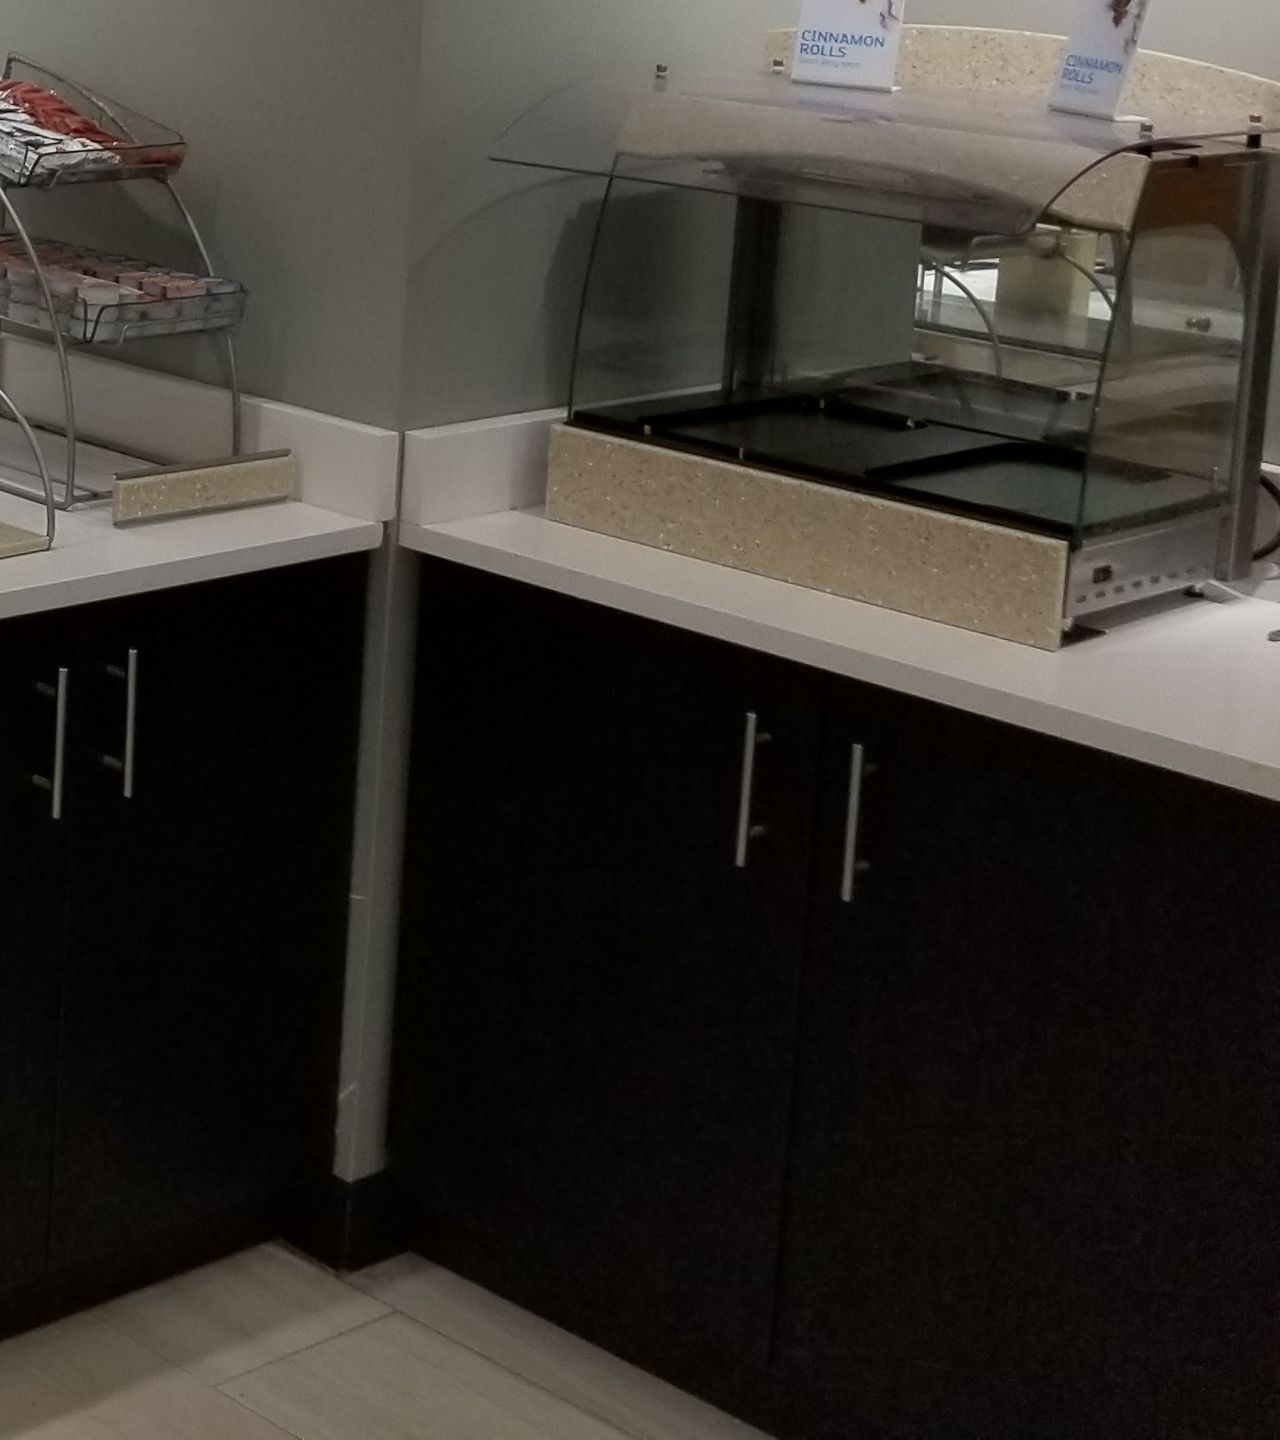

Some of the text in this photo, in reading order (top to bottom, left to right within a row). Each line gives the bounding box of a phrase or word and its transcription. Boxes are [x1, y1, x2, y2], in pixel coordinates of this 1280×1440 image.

[800, 28, 886, 48] CINNAMON
[799, 43, 847, 58] ROLLS
[1065, 54, 1124, 74] CINNAMON
[1061, 67, 1096, 85] ROLLS
